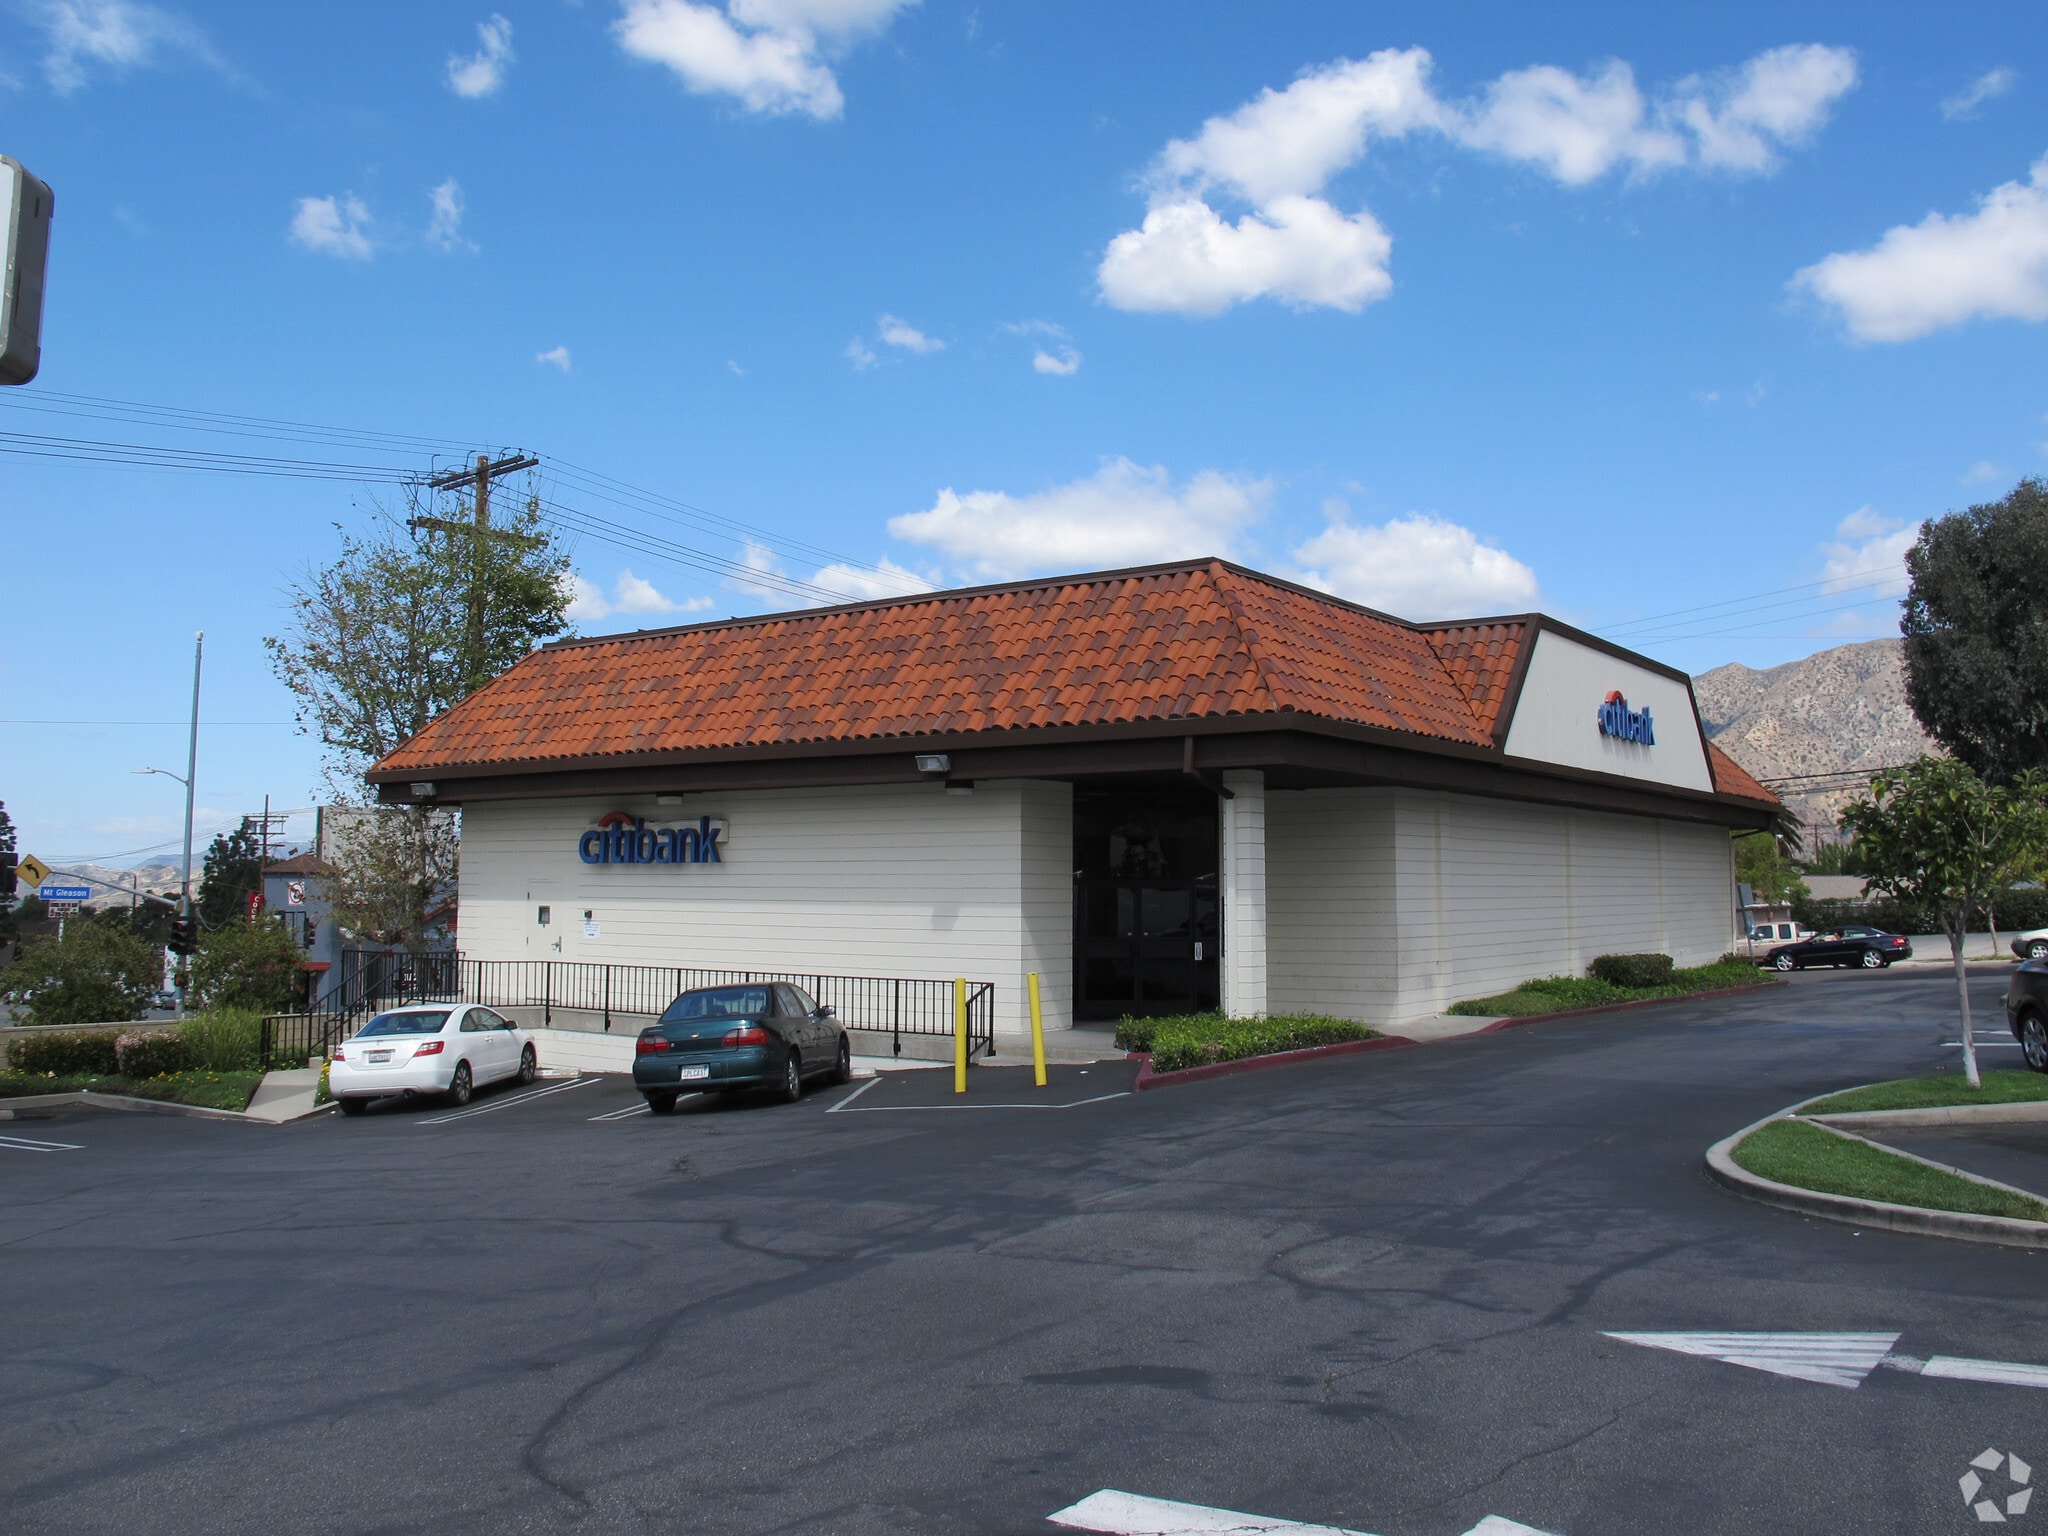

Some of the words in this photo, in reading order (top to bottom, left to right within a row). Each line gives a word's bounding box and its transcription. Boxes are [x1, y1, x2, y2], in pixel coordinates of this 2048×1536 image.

[1598, 690, 1655, 745] citibank
[579, 811, 722, 864] citibank
[56, 889, 87, 897] Gleason
